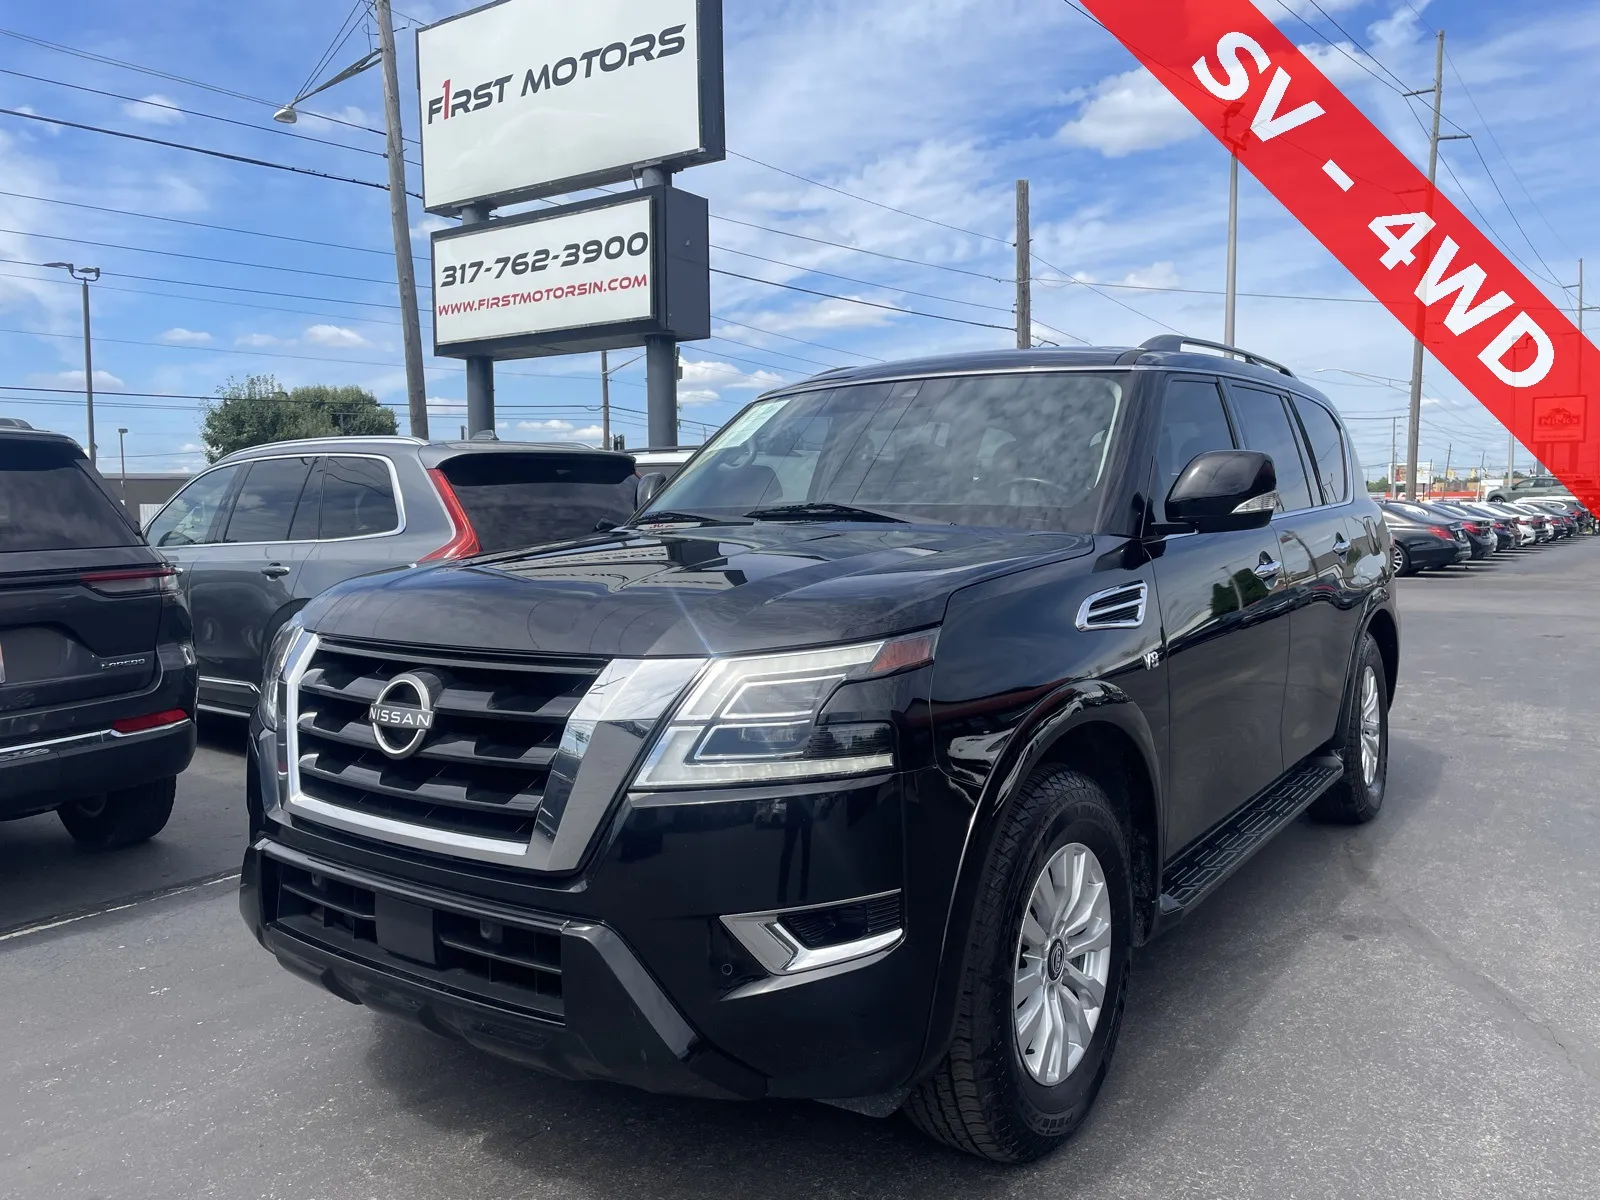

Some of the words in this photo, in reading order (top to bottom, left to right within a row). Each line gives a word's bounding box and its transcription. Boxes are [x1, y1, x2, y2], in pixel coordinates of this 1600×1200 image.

[520, 24, 687, 97] MOTORS
[440, 231, 649, 288] 317-762-3900
[437, 274, 648, 317] WWW.FIRSTMOTORSIN.COM
[368, 706, 431, 727] NISSAN
